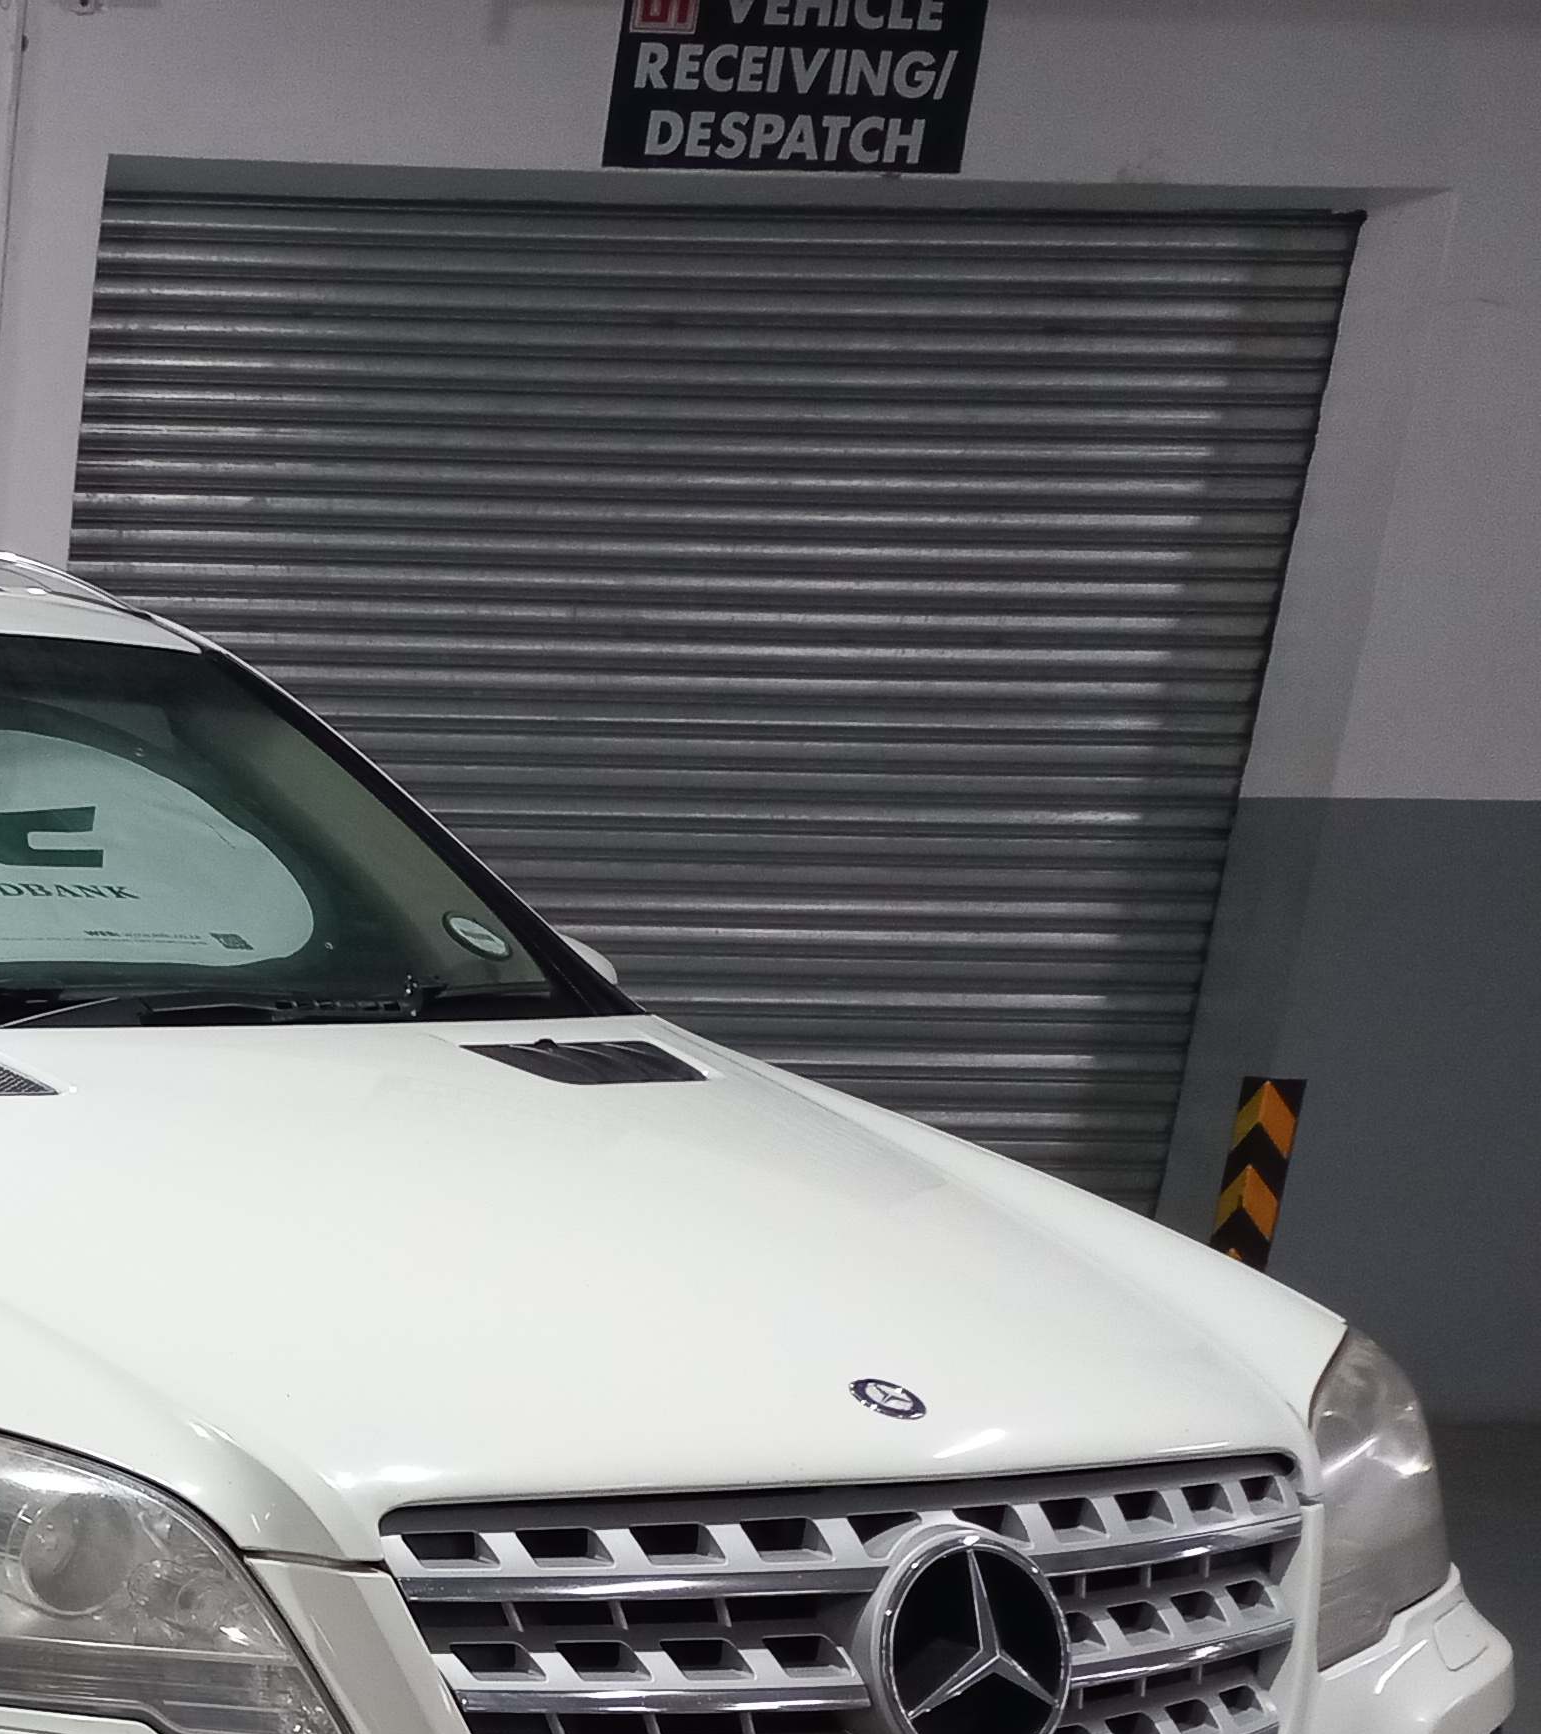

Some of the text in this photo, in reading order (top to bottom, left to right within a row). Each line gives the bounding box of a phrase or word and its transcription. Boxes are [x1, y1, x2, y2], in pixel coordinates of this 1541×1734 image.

[729, 0, 944, 31] VEHICLE
[633, 41, 959, 100] RECEIVING/
[643, 110, 926, 164] DESPATCH
